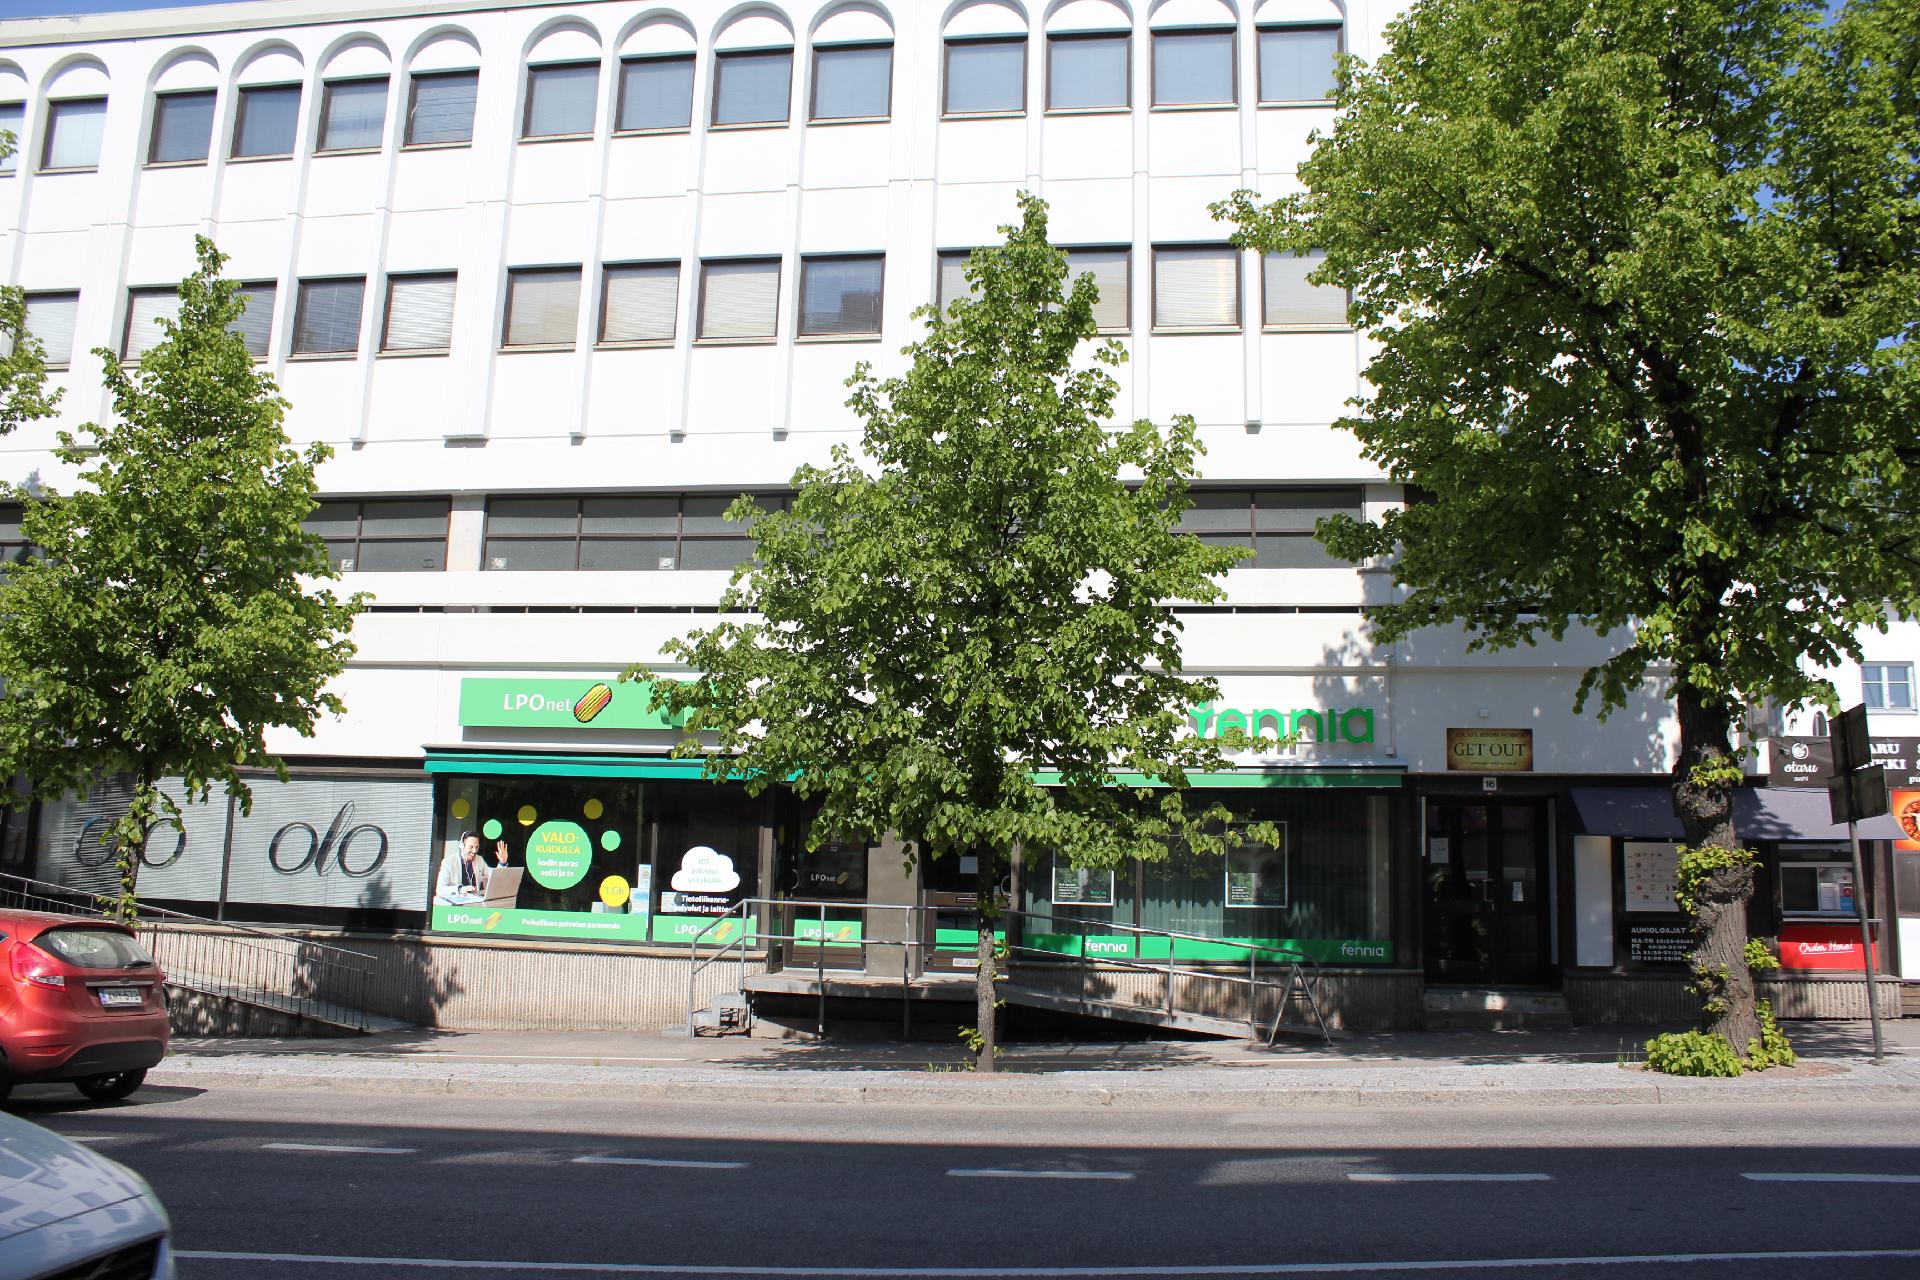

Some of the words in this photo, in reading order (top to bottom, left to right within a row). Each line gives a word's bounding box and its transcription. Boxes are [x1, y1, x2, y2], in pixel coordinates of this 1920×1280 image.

[1188, 700, 1374, 744] fennia
[1454, 743, 1486, 756] GET
[1489, 743, 1526, 756] OUT
[1784, 760, 1819, 773] otaru
[1485, 780, 1496, 789] 16
[268, 799, 388, 878] olo
[541, 831, 580, 844] VALO-
[535, 844, 580, 854] KUIDULLA
[673, 903, 702, 913] palvelut
[702, 904, 710, 914] ja
[1084, 938, 1128, 953] fennia
[1340, 942, 1384, 957] fennia
[1798, 942, 1827, 953] Order
[1828, 940, 1854, 952] Here!
